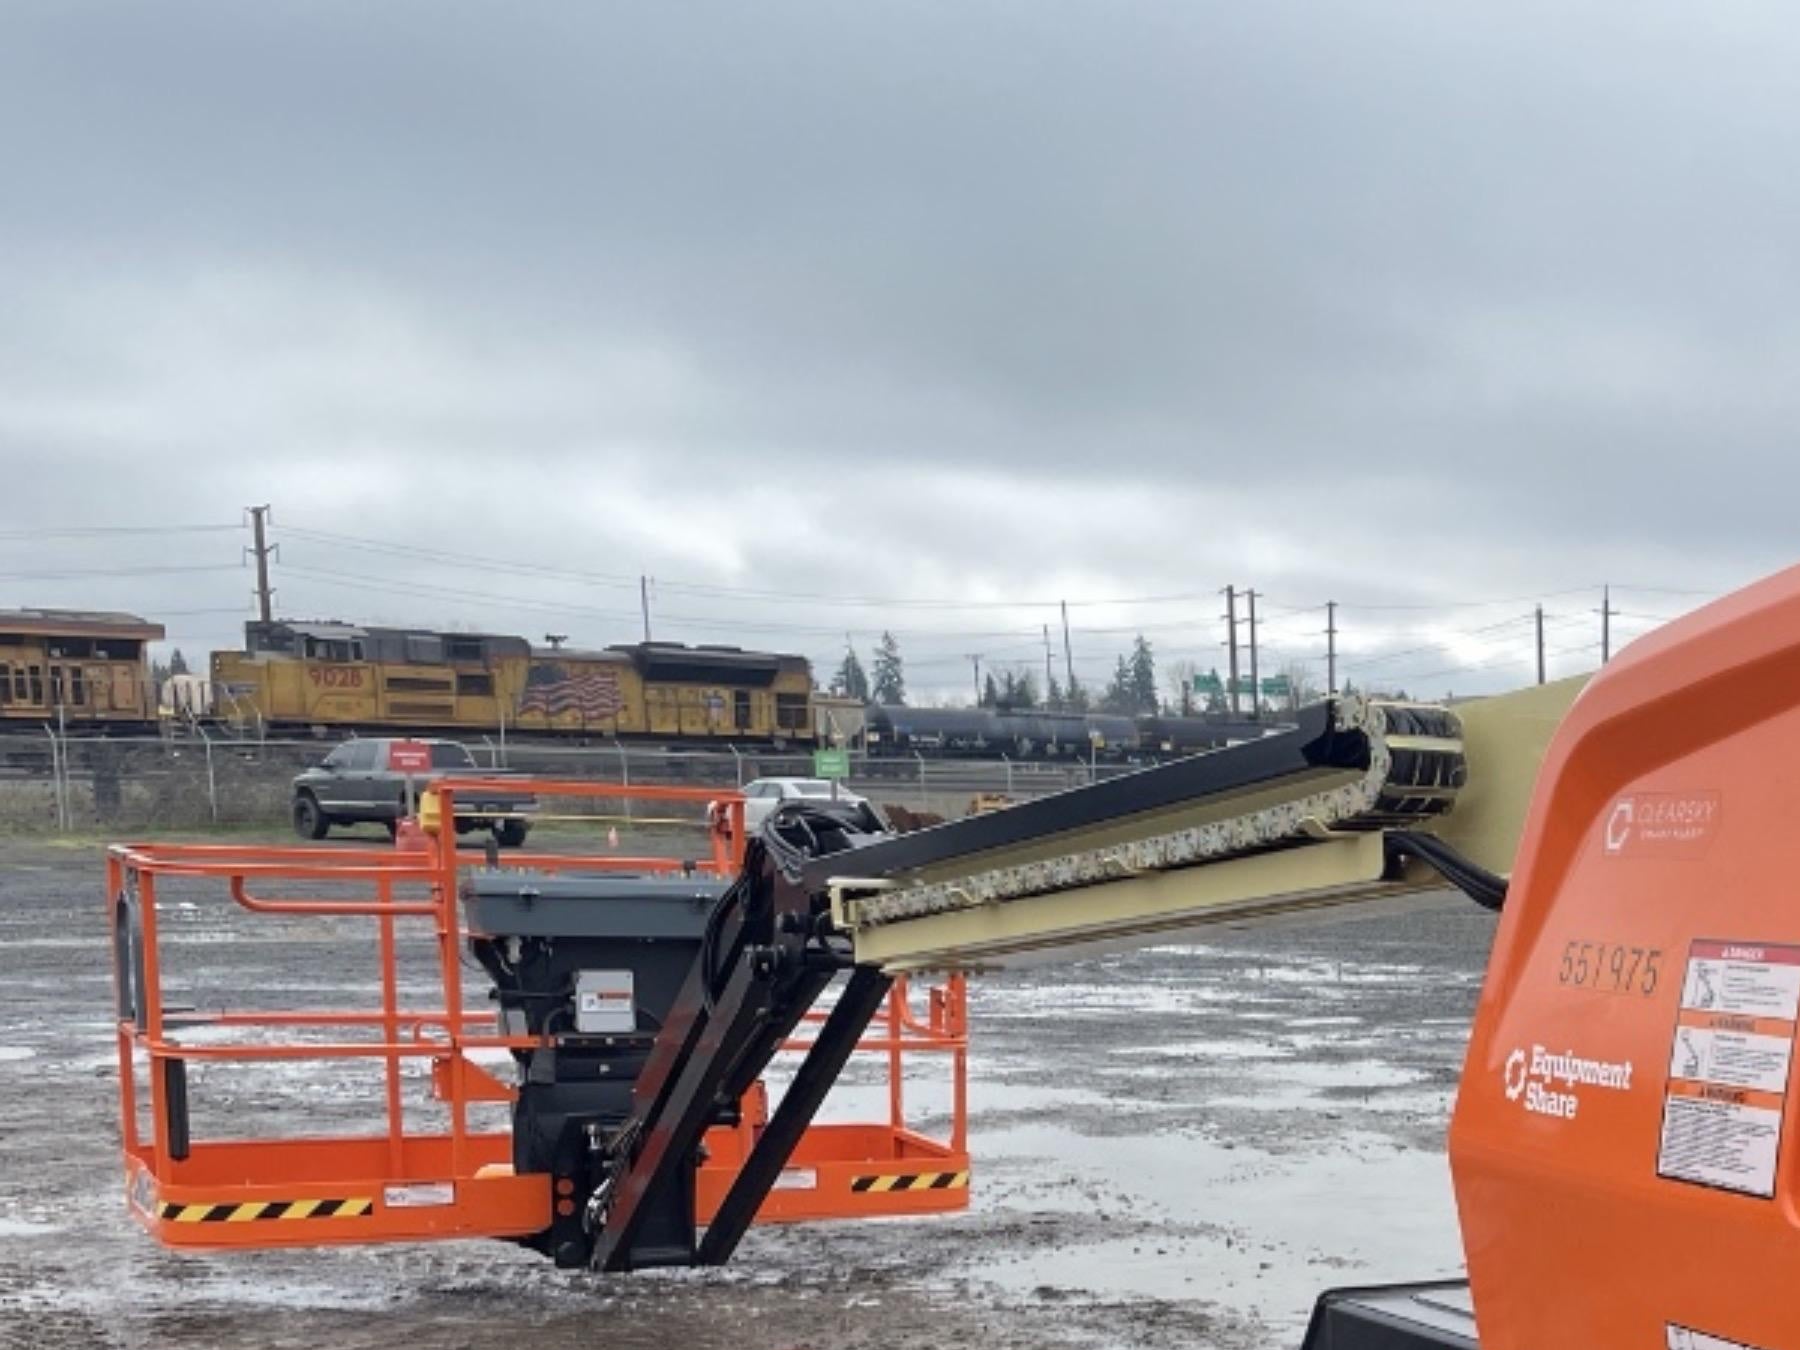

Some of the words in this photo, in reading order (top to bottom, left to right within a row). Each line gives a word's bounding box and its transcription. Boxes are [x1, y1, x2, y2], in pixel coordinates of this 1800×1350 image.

[1559, 940, 1662, 995] 551975
[1529, 1043, 1633, 1090] Equipment
[1523, 1080, 1579, 1120] Share
